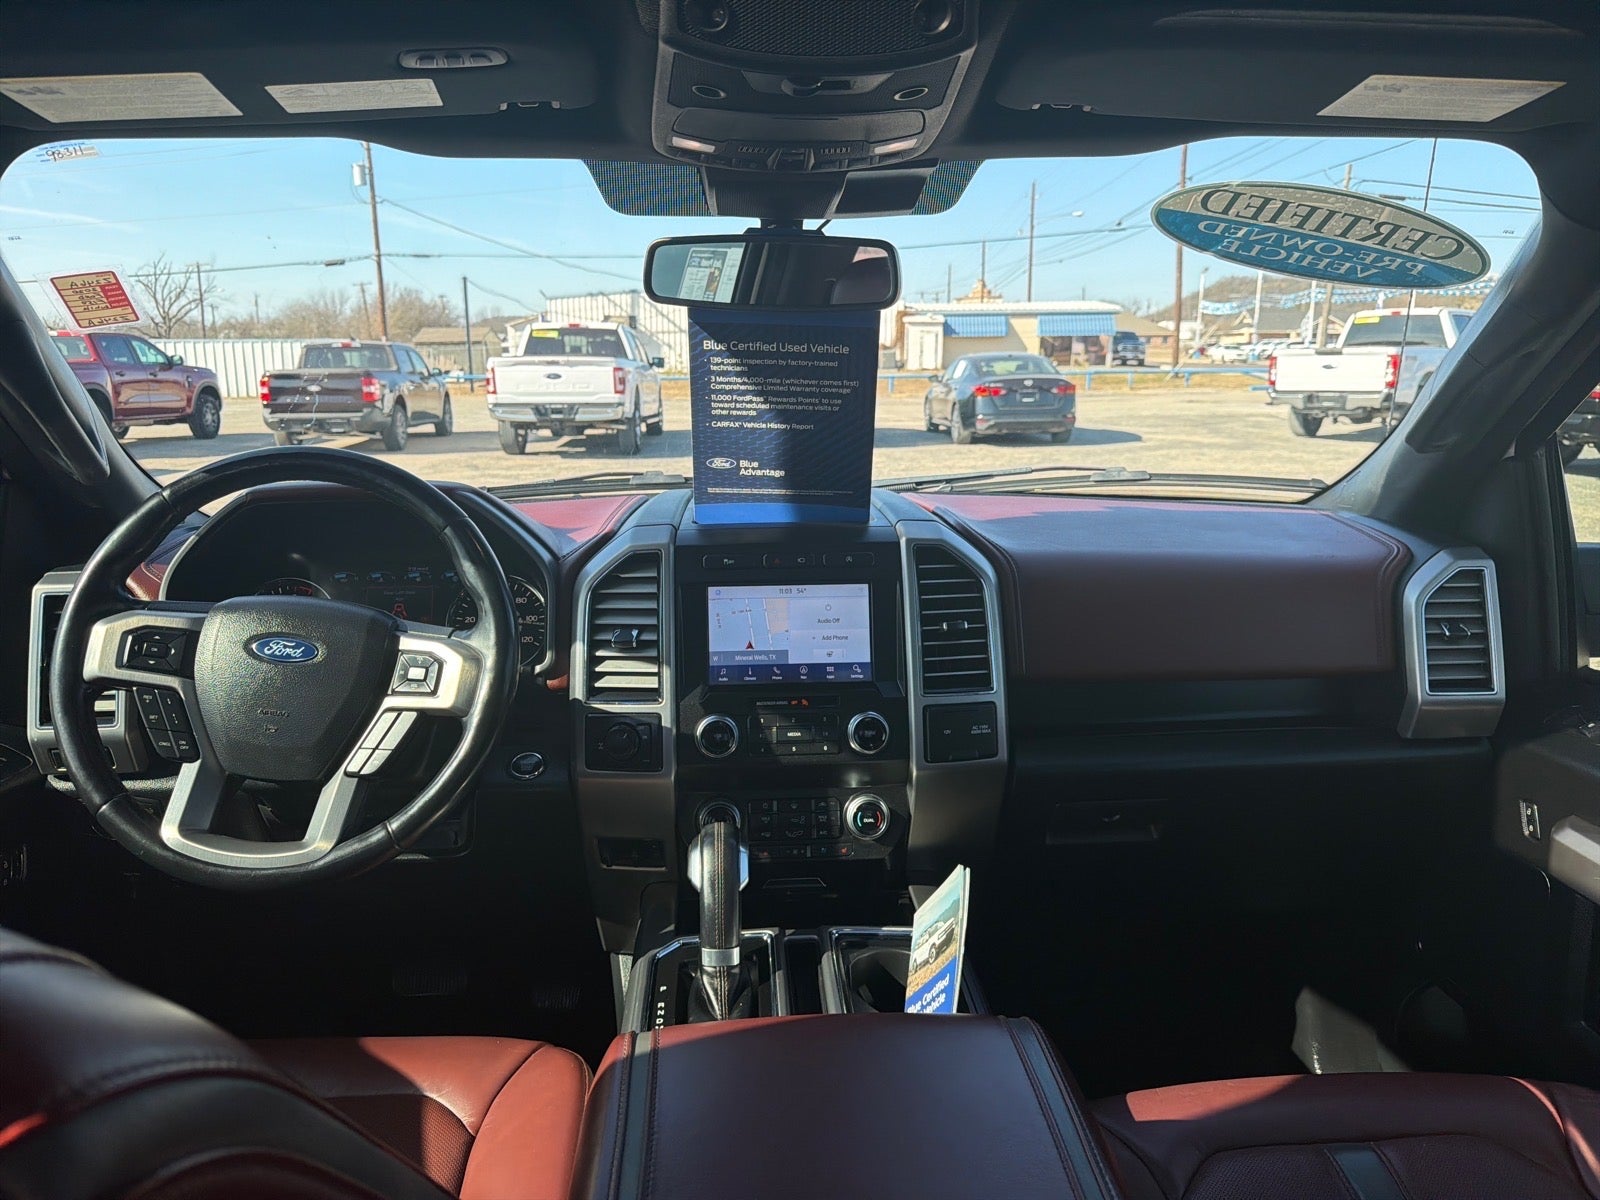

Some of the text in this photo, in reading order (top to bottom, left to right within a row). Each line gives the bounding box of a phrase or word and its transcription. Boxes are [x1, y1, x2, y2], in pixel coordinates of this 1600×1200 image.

[703, 340, 850, 354] Blue Certified Used Vehicle
[788, 359, 838, 367] factory-trained
[843, 379, 859, 387] first)
[739, 468, 785, 477] Advantage
[922, 973, 950, 1005] Certified
